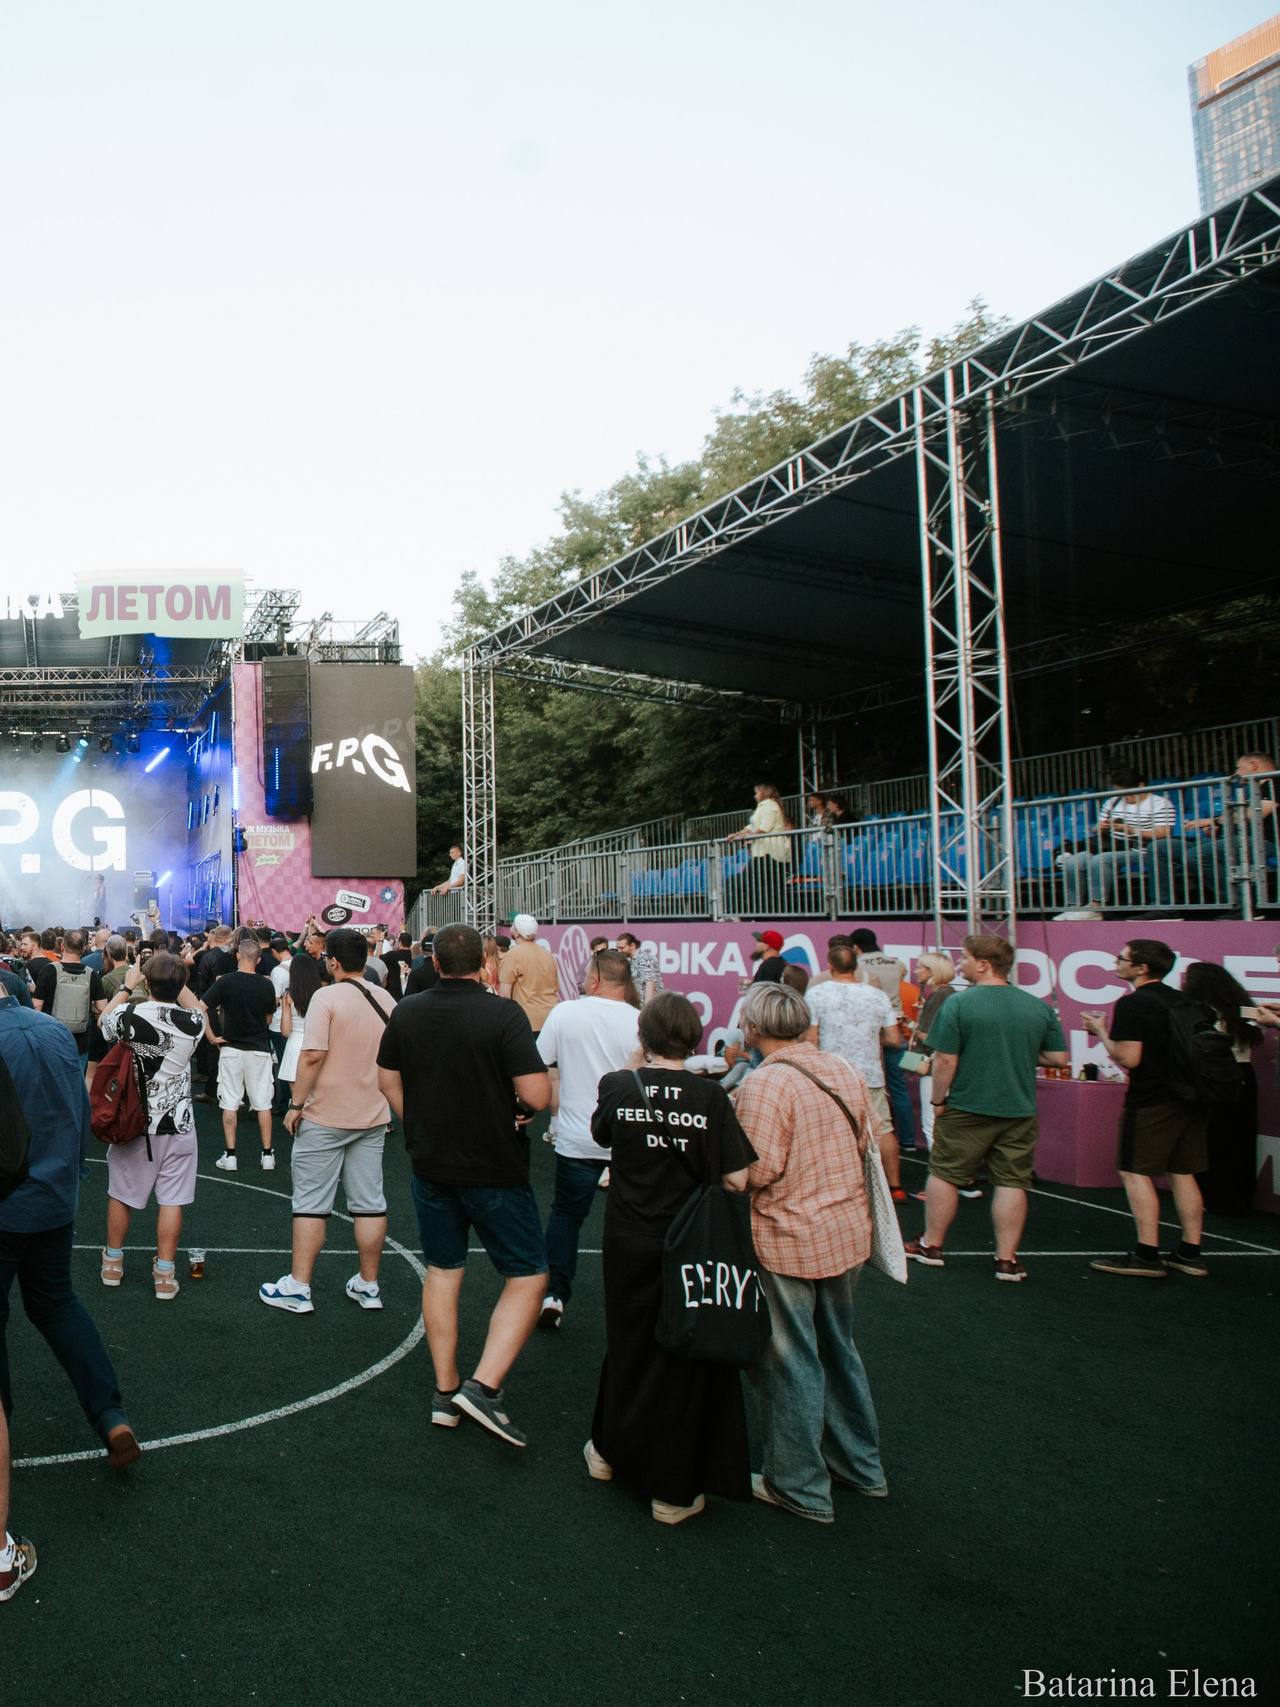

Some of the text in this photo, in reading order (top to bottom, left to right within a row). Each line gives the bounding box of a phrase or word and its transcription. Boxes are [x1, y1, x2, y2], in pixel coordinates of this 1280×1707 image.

[86, 584, 231, 621] ЛЕТОМ
[256, 825, 290, 833] МУЗЫКА
[645, 1085, 682, 1100] IF IT
